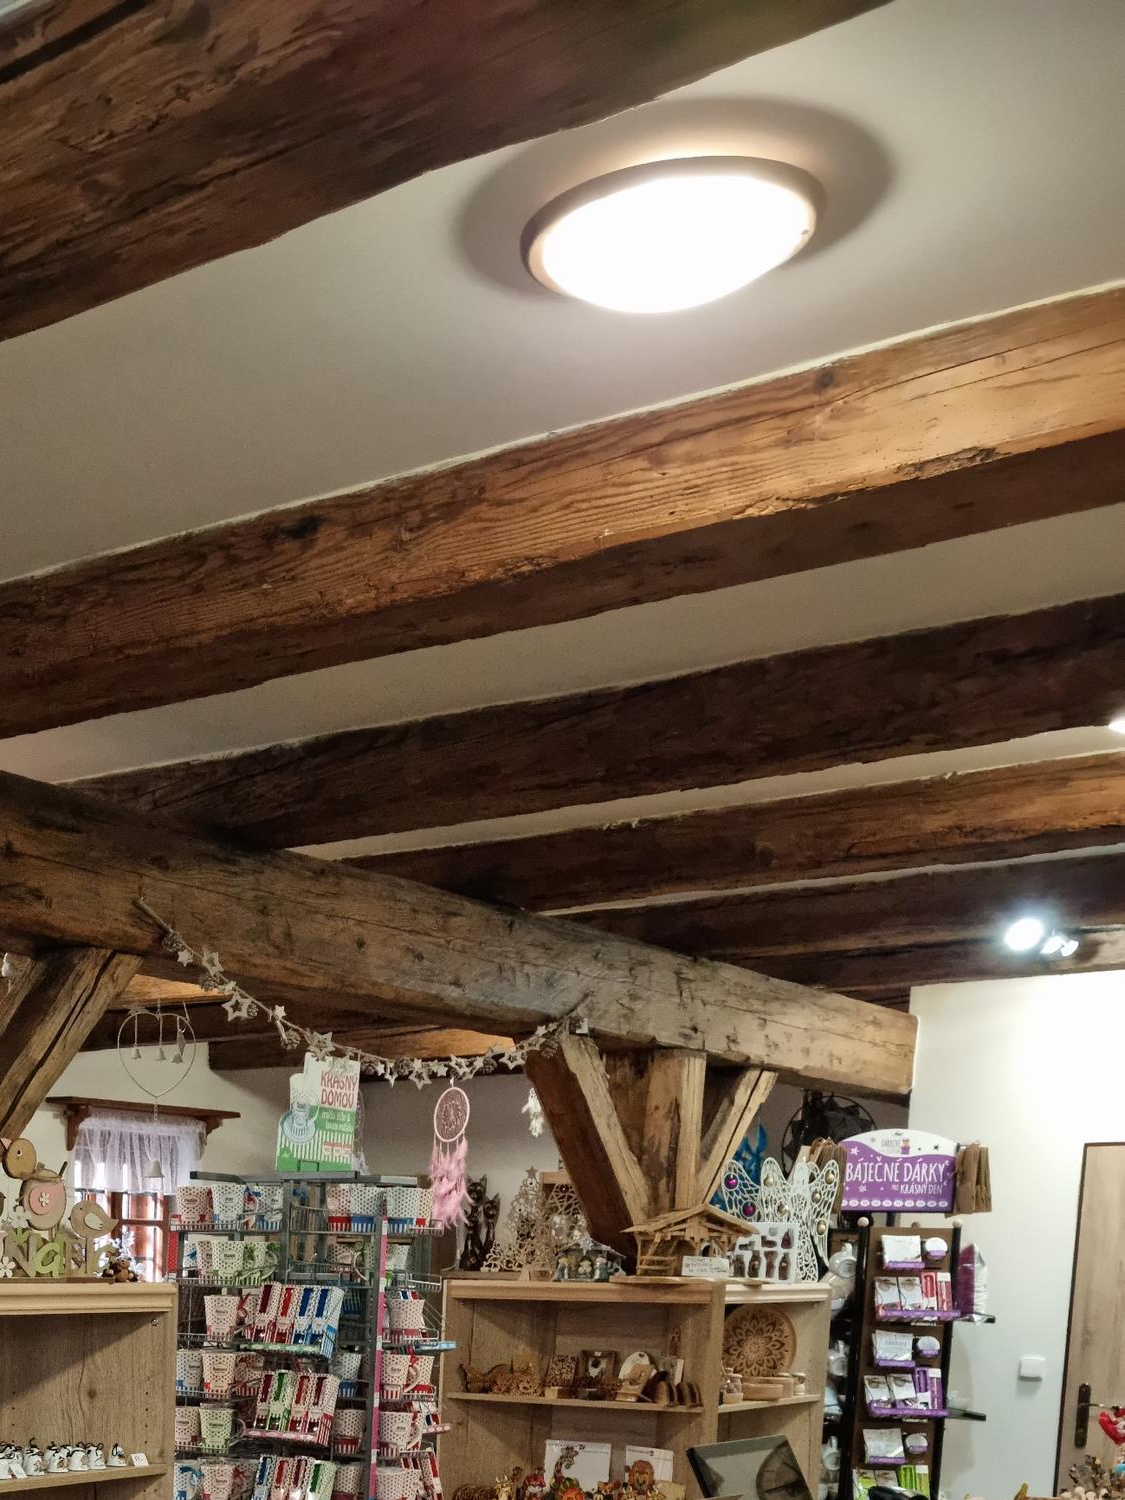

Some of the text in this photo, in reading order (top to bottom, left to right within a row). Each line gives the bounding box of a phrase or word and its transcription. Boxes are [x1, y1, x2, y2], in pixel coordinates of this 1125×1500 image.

[845, 1156, 945, 1184] BÁJEČNÉ DÁRKY
[900, 1181, 928, 1195] KRÁSNÝ
[928, 1183, 943, 1195] DEN
